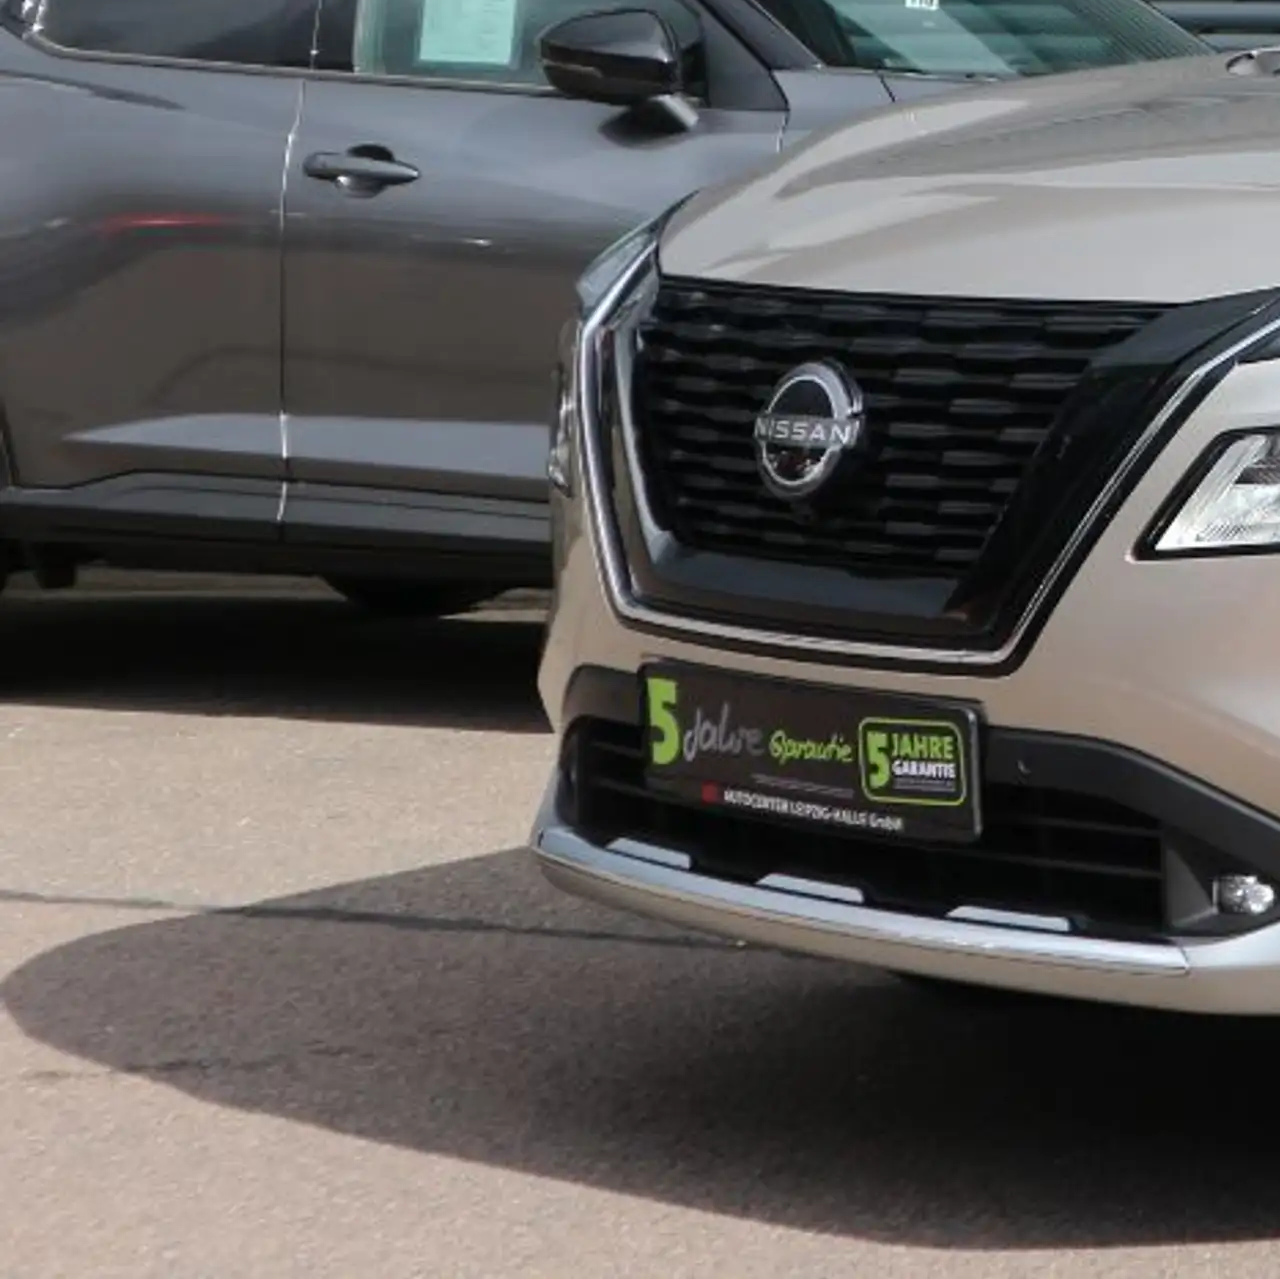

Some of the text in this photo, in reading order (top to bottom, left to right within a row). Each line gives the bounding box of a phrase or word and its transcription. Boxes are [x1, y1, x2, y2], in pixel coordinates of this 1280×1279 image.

[754, 417, 861, 446] NISSAN
[647, 677, 679, 765] 5
[866, 730, 890, 789] 5
[891, 732, 955, 760] JAHRE
[891, 759, 956, 779] GARANTIE
